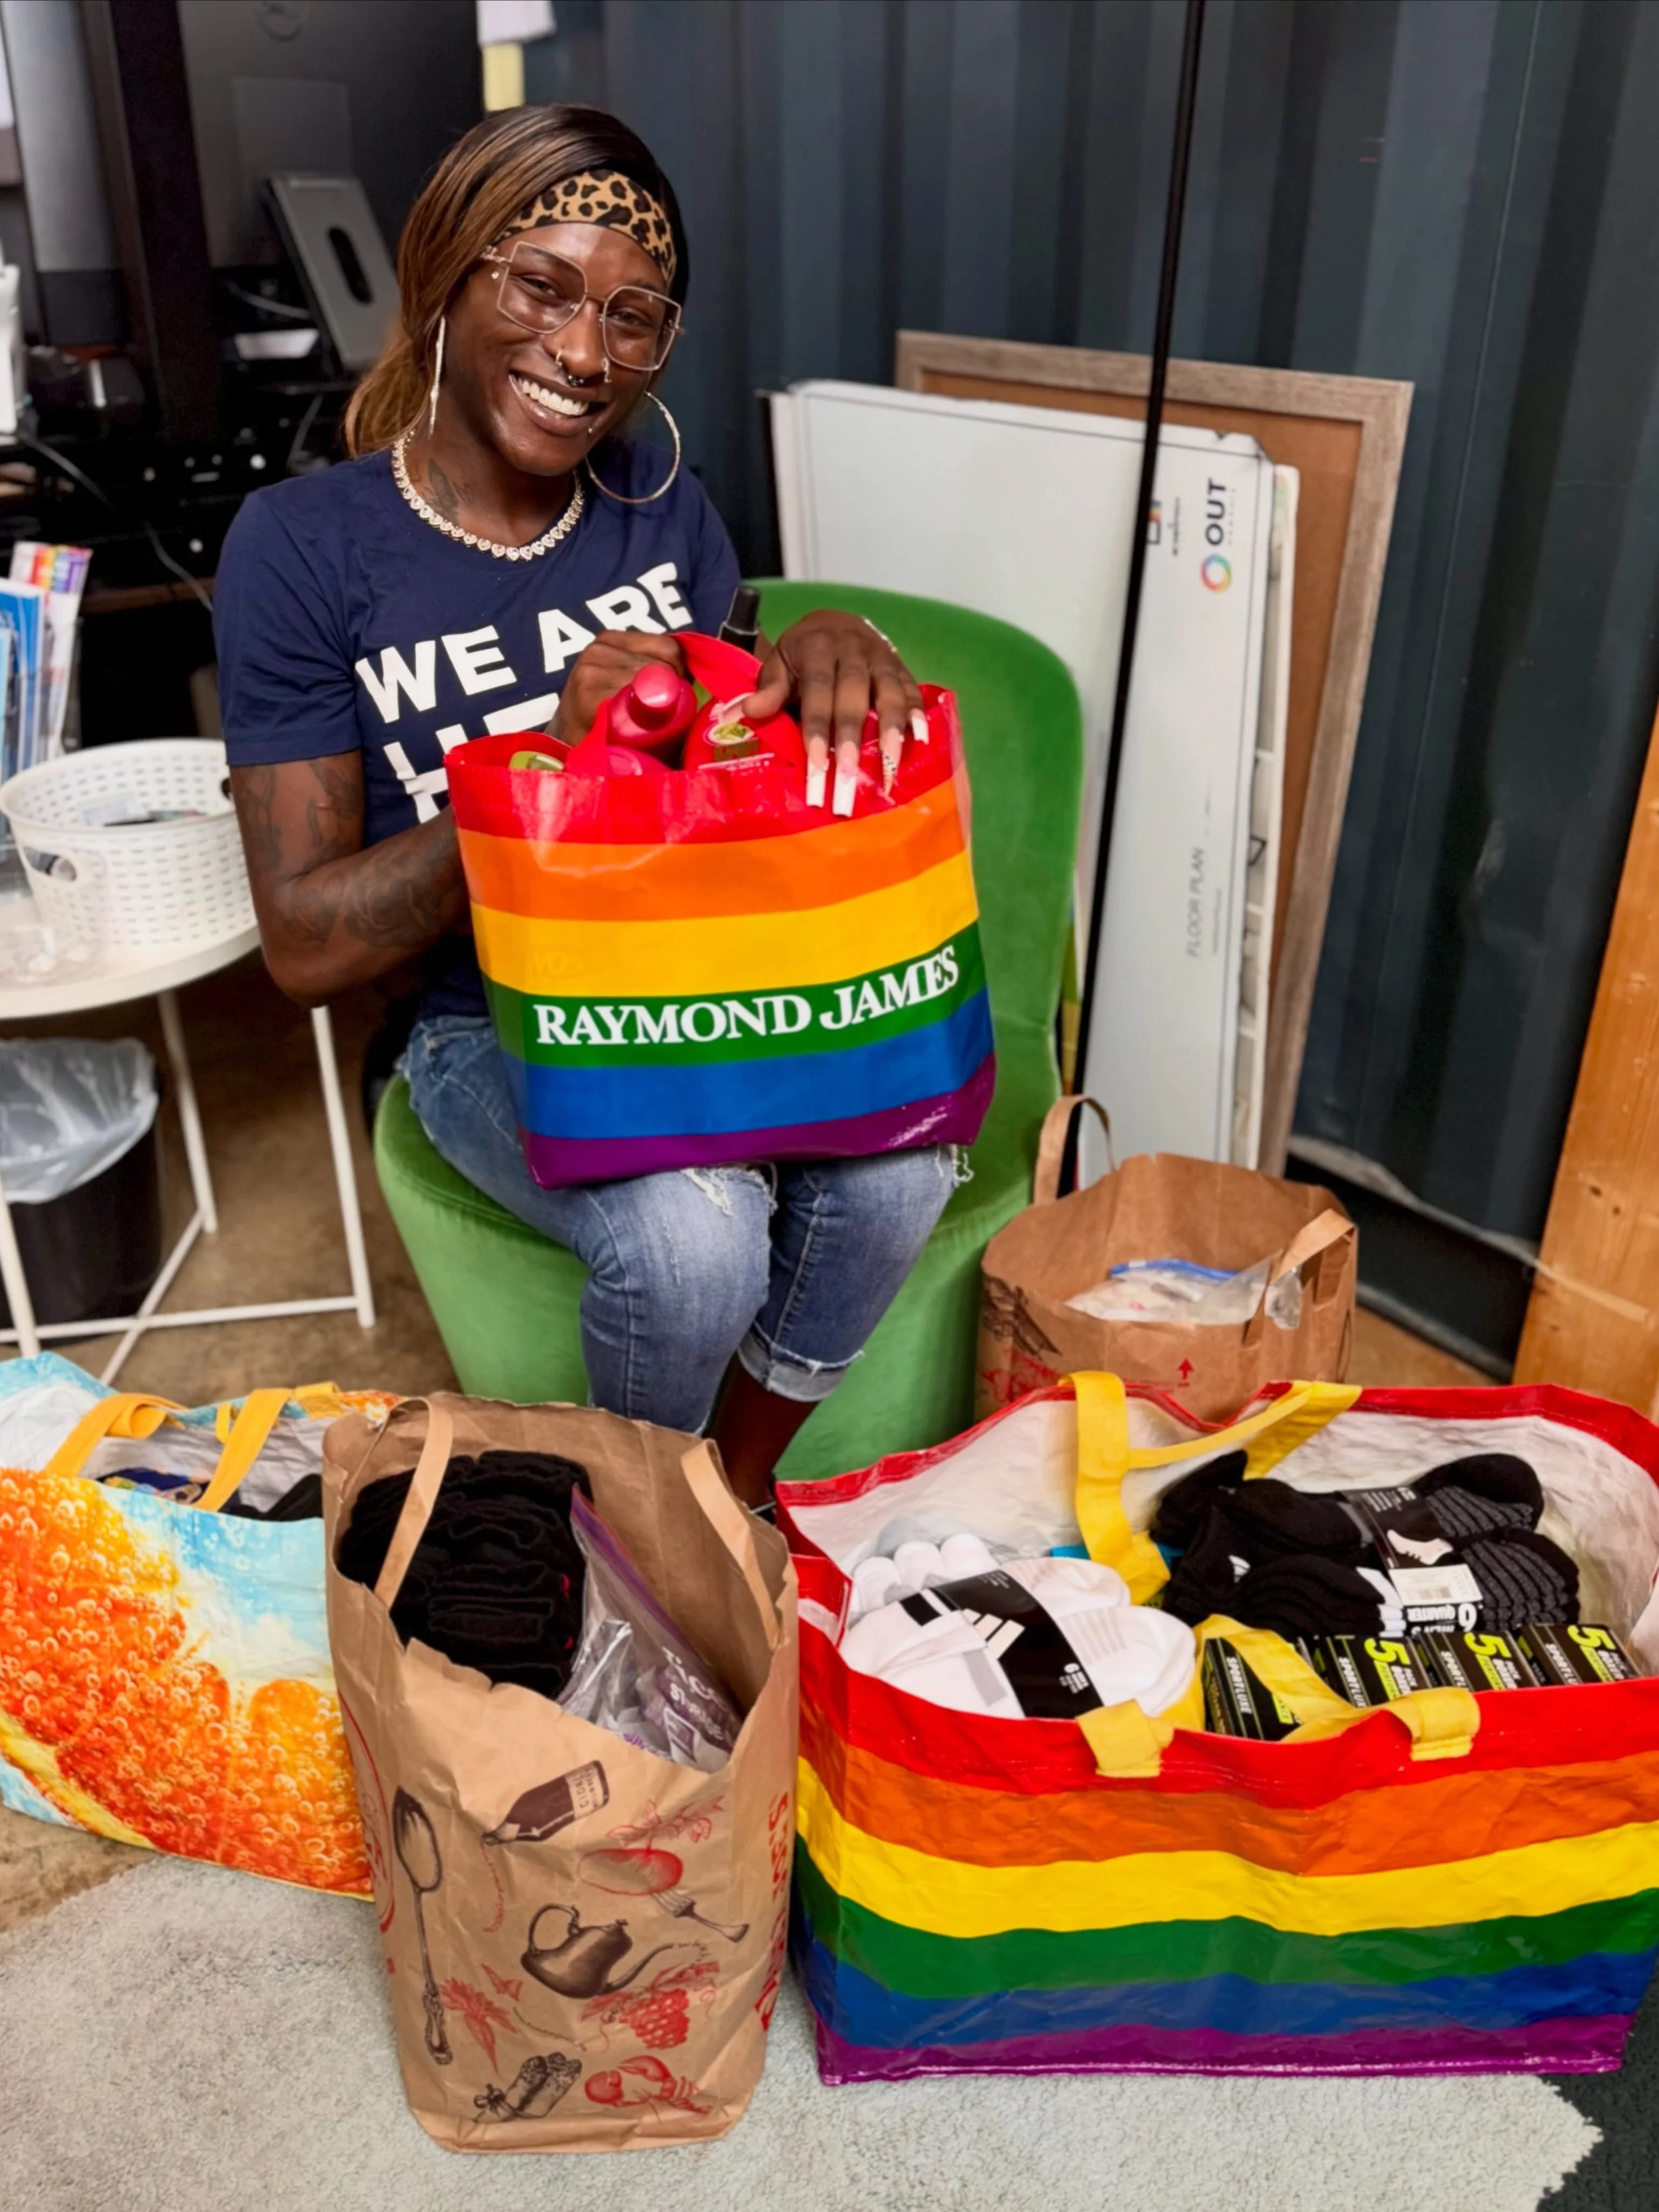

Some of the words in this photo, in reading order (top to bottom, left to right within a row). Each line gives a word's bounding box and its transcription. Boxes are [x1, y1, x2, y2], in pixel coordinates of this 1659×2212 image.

[1205, 478, 1226, 546] OUT
[355, 625, 517, 723] WE
[538, 562, 693, 673] ARE
[533, 994, 812, 1045] RAYMOND
[820, 945, 960, 1030] JAMES
[1407, 1604, 1456, 1622] QUARTER
[1464, 1632, 1512, 1658] 5
[1567, 1625, 1616, 1650] 5
[1364, 1638, 1411, 1665] 5
